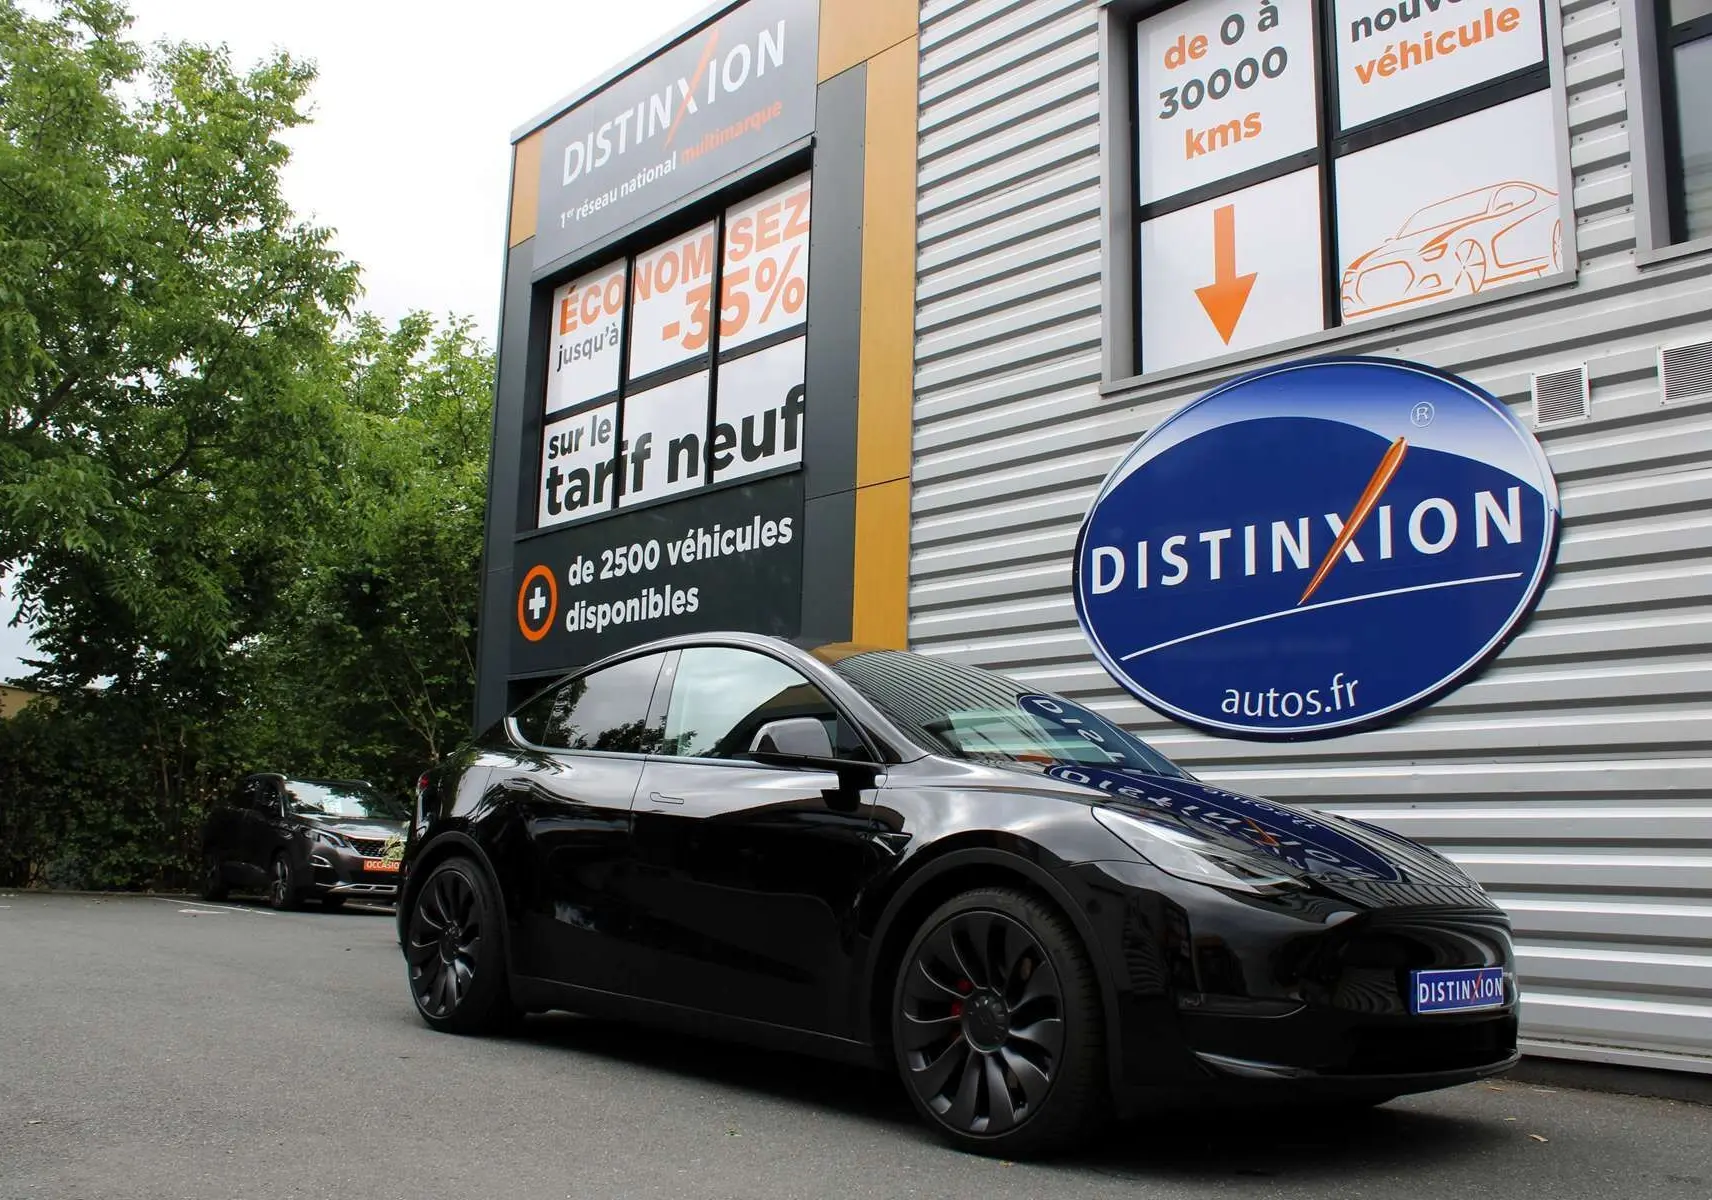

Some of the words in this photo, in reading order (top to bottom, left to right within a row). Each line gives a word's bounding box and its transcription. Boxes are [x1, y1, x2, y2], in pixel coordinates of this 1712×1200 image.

[1164, 34, 1208, 69] de
[1257, 0, 1279, 32] à
[1354, 7, 1520, 85] véhicule
[562, 20, 786, 187] DISTINXION
[1159, 46, 1288, 120] 30000
[576, 187, 618, 221] réseau
[620, 150, 676, 198] national
[683, 100, 783, 165] multimarque
[1185, 111, 1262, 161] kms
[556, 322, 619, 372] jusqu'à
[662, 244, 806, 350] -35%
[547, 423, 585, 461] sur
[590, 413, 612, 447] le
[666, 383, 806, 484] neuf
[567, 554, 594, 587] de
[600, 538, 661, 580] 2500
[667, 513, 794, 567] véhicules
[1092, 486, 1523, 595] DISTINXION
[565, 584, 700, 634] disponibles
[1221, 672, 1360, 718] autos.fr
[1419, 976, 1503, 1004] DISTINXION
